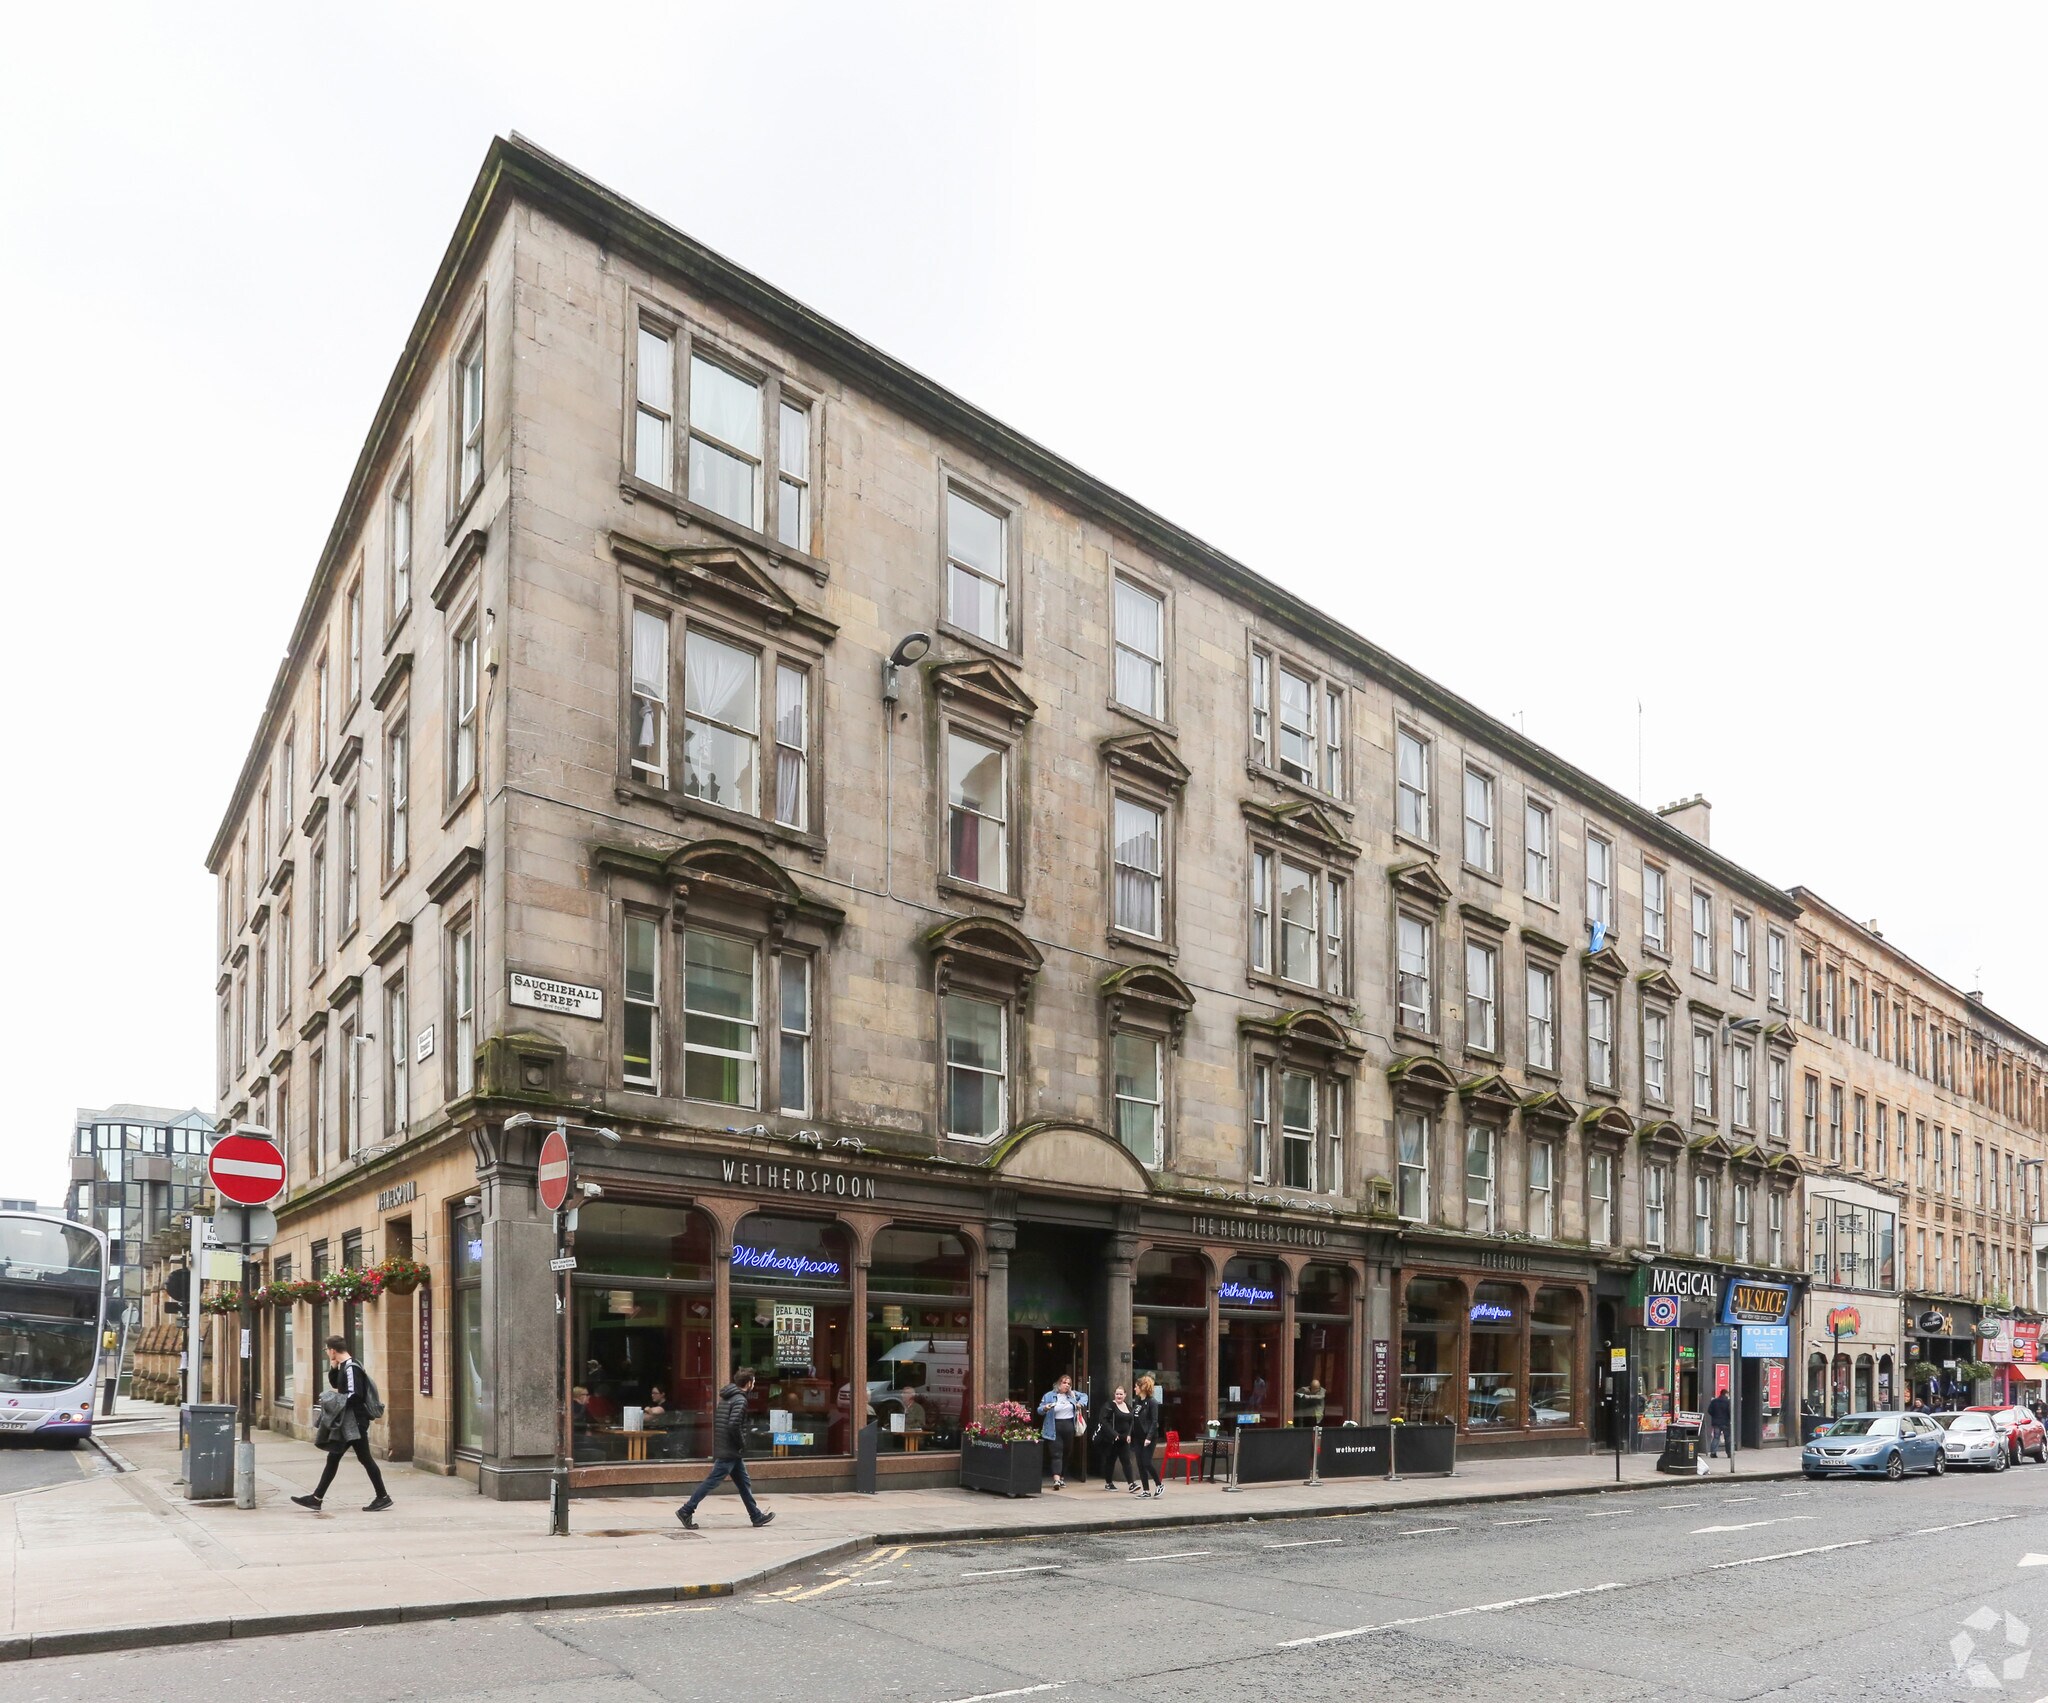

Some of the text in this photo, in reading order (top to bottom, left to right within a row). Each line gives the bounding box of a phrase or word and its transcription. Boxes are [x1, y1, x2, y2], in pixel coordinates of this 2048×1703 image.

[514, 975, 599, 1000] SAUCHIEHALL
[533, 989, 581, 1008] STREET
[722, 1159, 875, 1199] WETHERSPOON
[1192, 1216, 1327, 1247] THE HENGLERS CIRCUS
[732, 1244, 839, 1277] Wetherspoon
[1481, 1252, 1531, 1271] FREEHOUSE
[1653, 1269, 1717, 1296] MAGICAL
[1734, 1287, 1784, 1313] NY SLICE
[776, 1306, 812, 1317] REAL ALES
[777, 1335, 795, 1345] CRAFT
[1745, 1328, 1785, 1336] TO LET
[1335, 1445, 1376, 1454] wetherspoon
